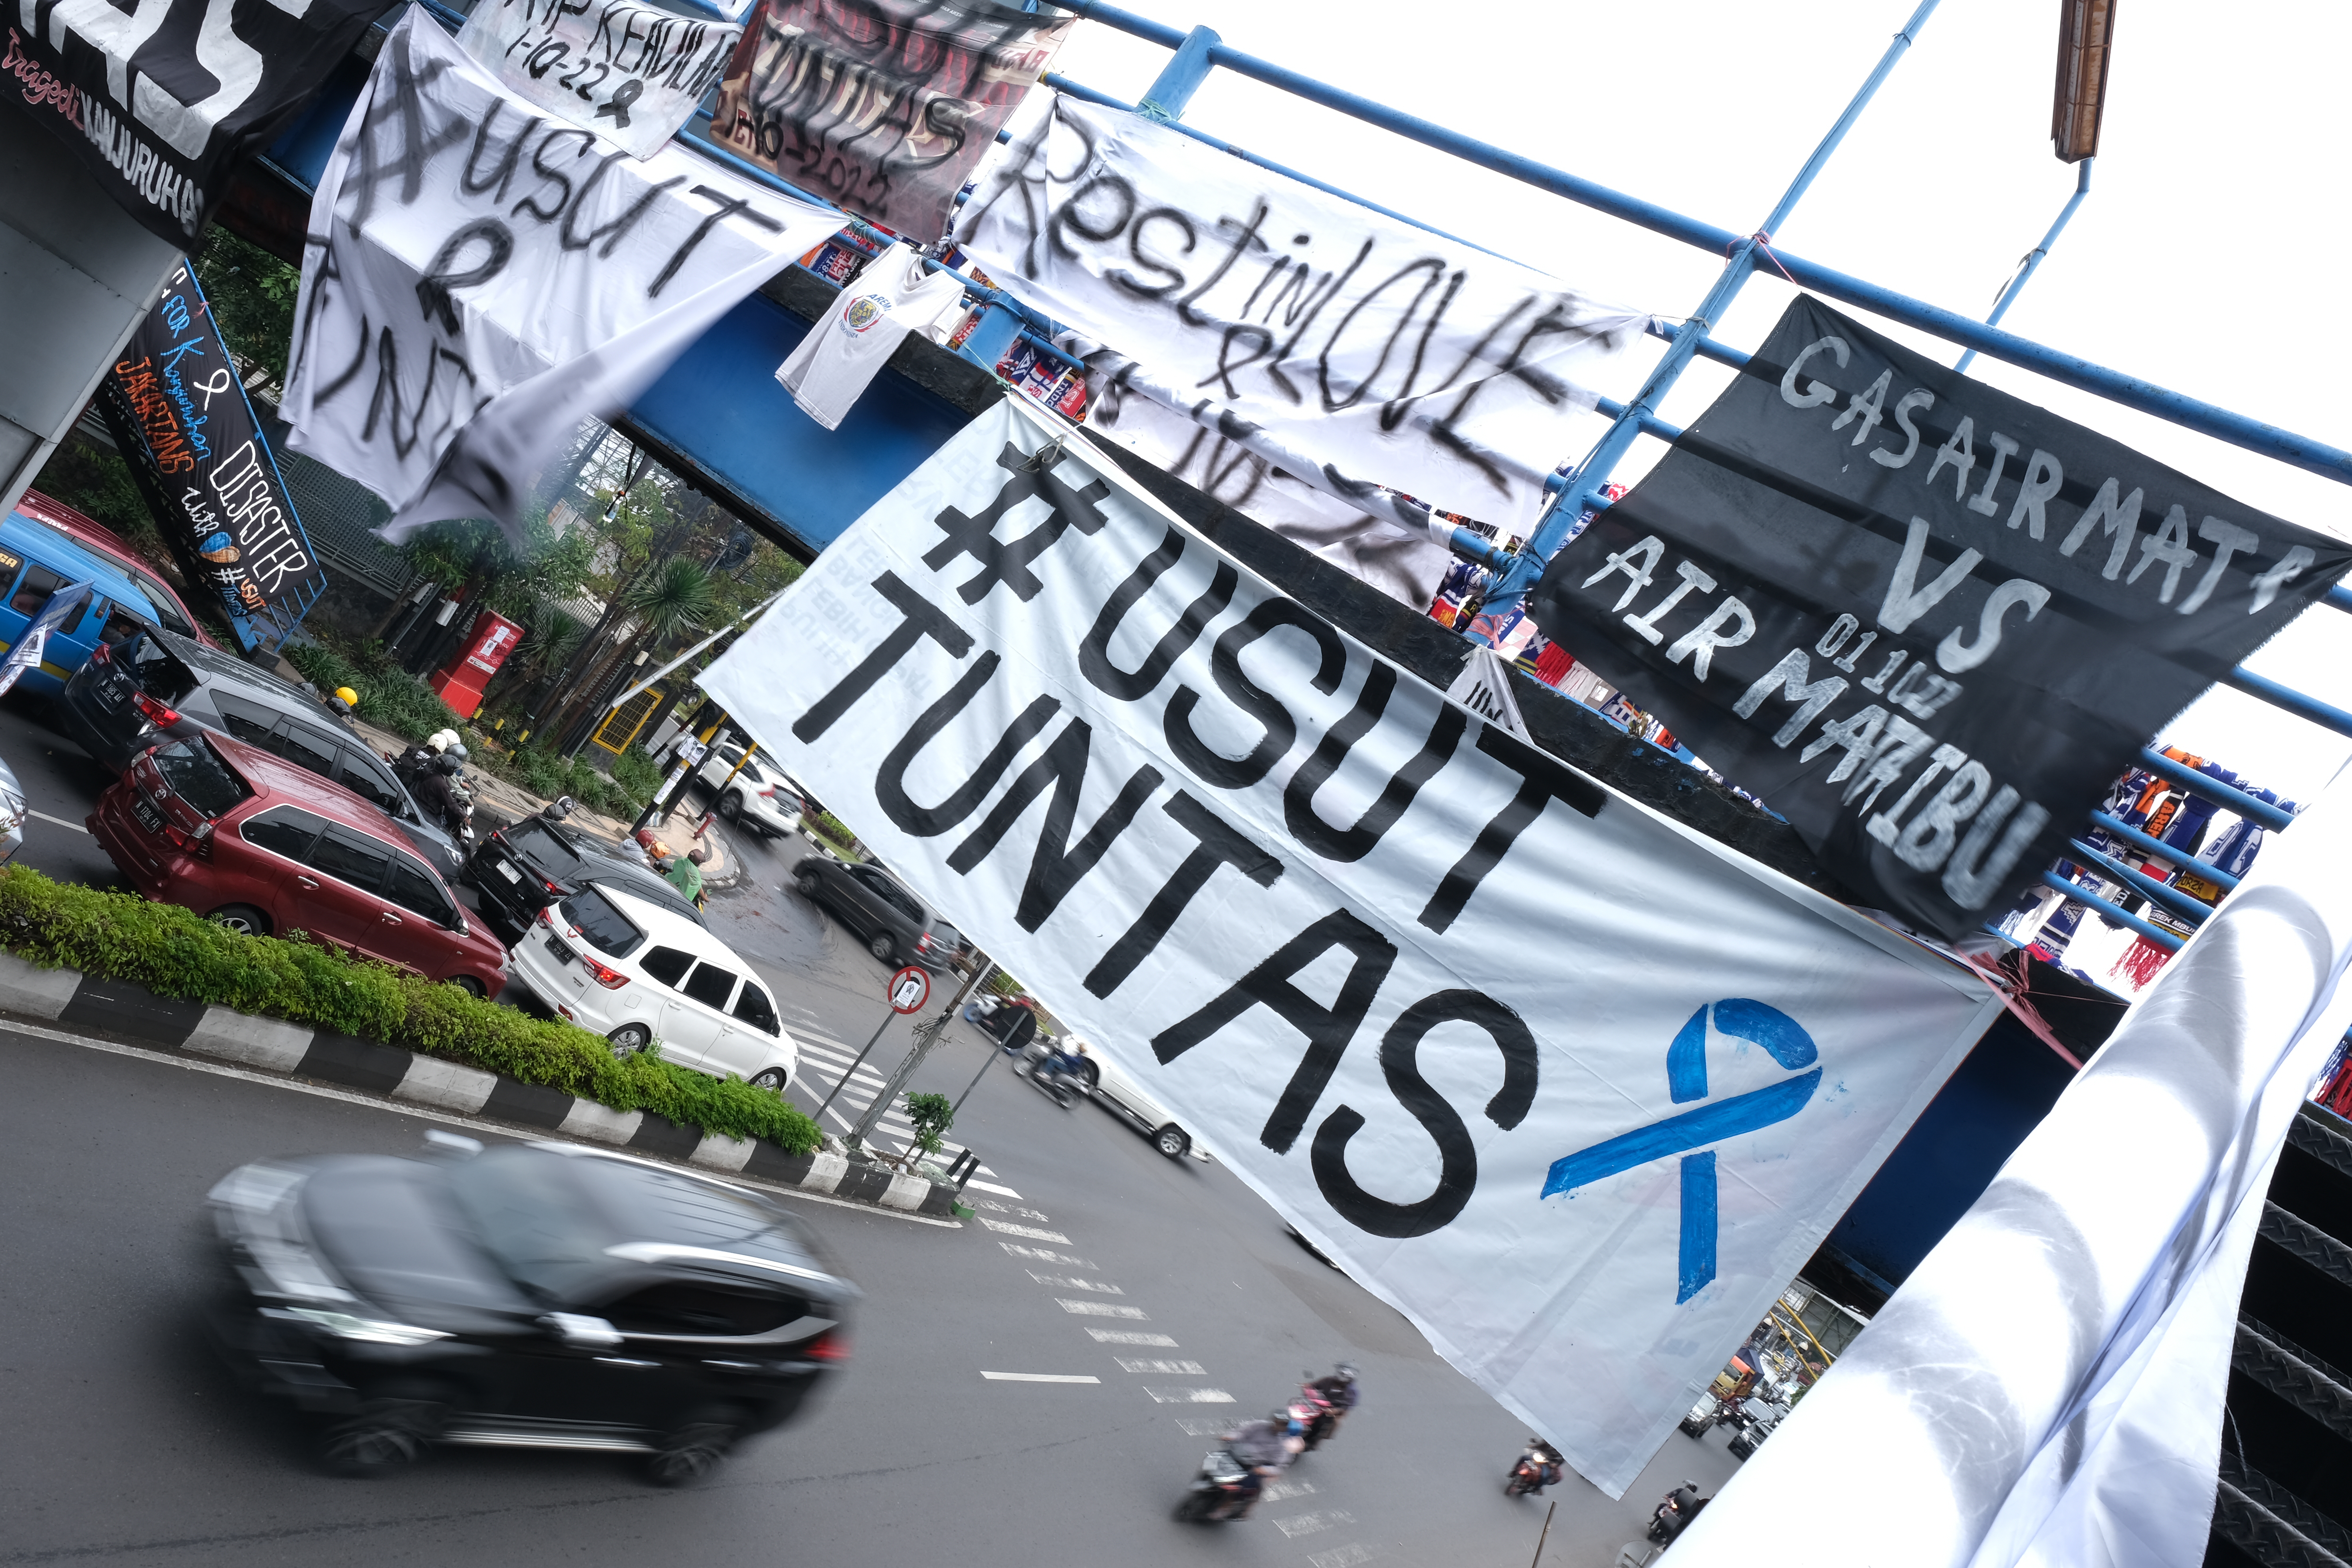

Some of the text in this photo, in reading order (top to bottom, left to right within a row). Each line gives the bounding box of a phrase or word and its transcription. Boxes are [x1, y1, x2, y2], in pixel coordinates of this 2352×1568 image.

[209, 439, 309, 594] DISASTER
[1779, 335, 1935, 469] GAS
[1927, 416, 2065, 542] AIR
[1581, 534, 1757, 683] AIR
[1877, 515, 2051, 674] VS
[922, 440, 1607, 935] #USUT
[135, 799, 161, 829] N 1704 FX
[792, 569, 1541, 1239] TUNTAS
